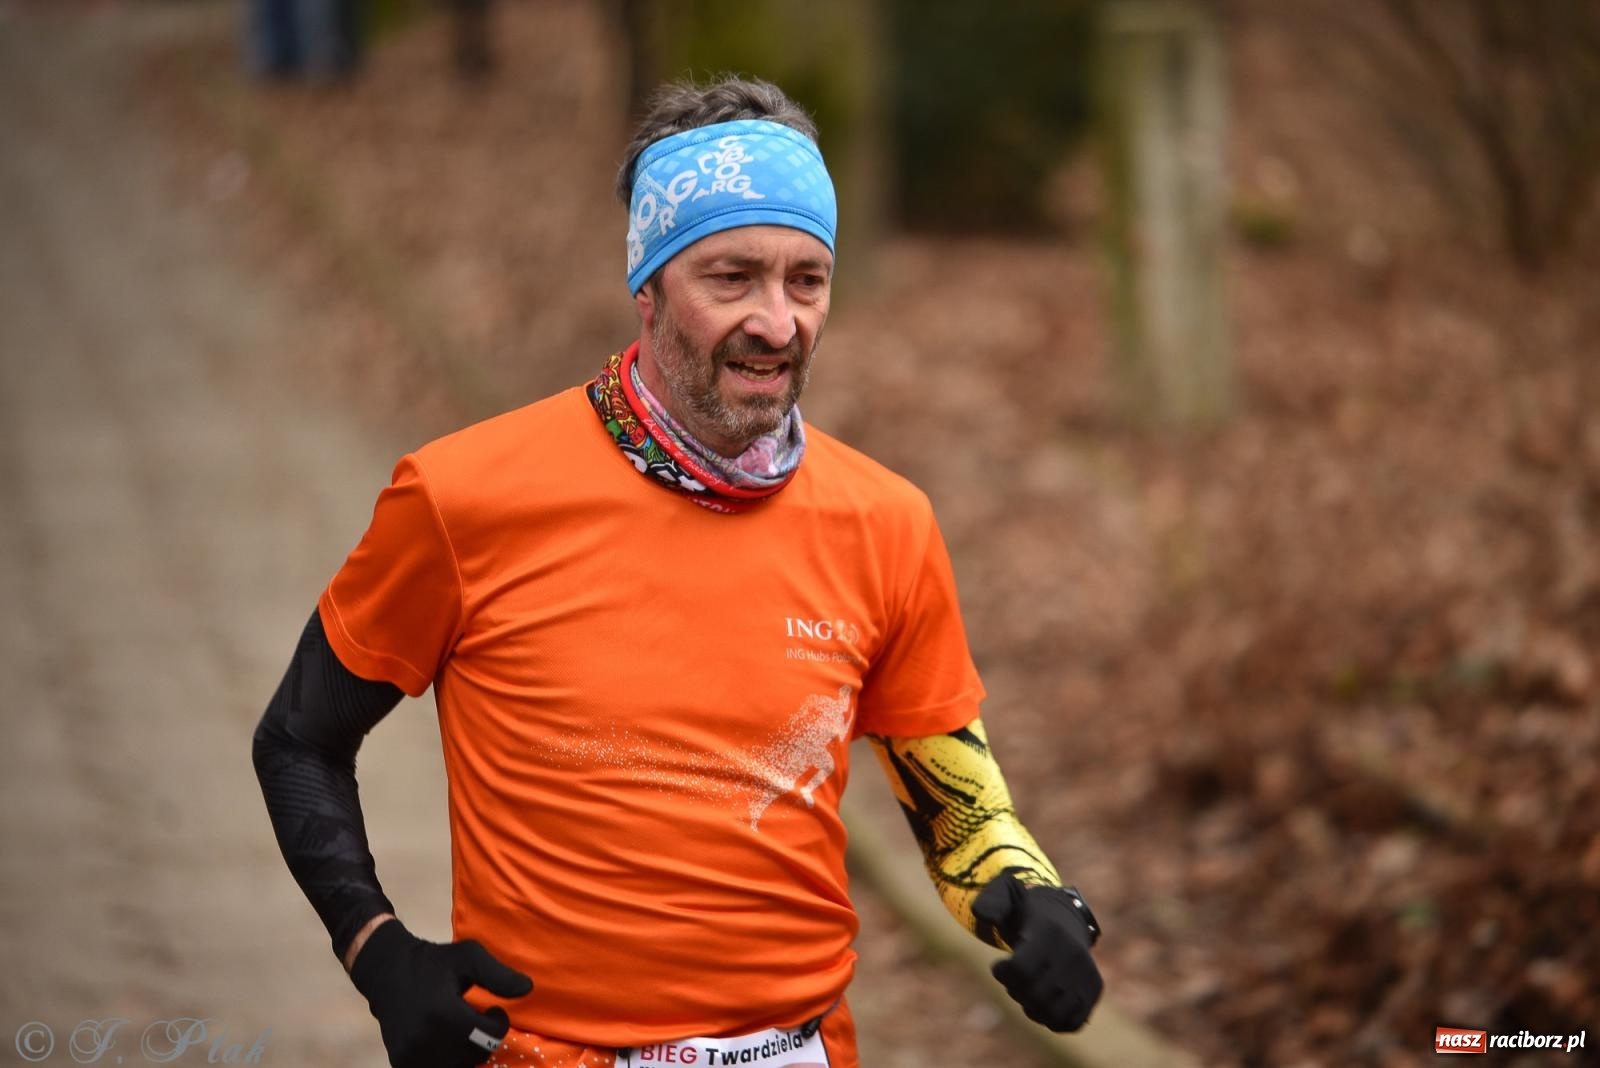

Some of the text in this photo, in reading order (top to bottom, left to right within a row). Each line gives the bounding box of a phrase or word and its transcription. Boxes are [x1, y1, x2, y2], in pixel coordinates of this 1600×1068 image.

[785, 617, 833, 641] ING
[786, 648, 805, 661] ING
[807, 650, 830, 662] Hubs
[640, 1032, 803, 1066] BIEG Twardziela
